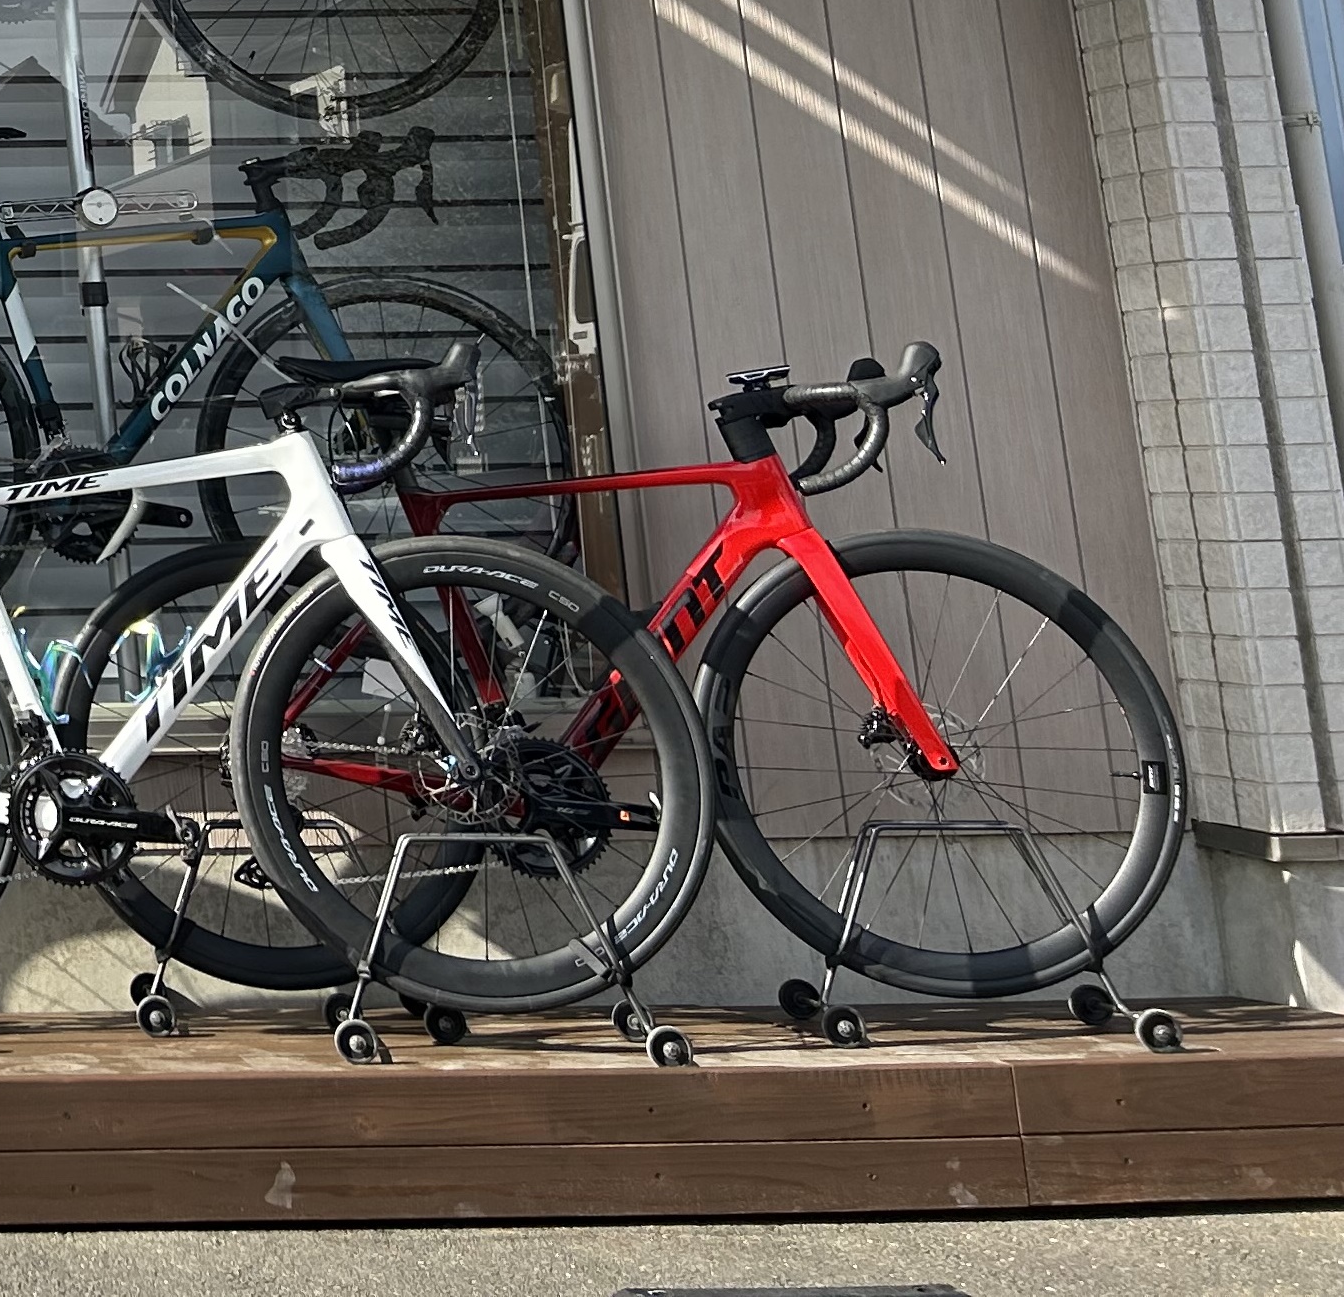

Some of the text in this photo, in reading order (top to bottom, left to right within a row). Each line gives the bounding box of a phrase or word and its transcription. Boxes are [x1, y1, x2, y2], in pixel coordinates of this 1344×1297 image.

[151, 276, 265, 421] COLNAGO
[6, 473, 109, 501] TIME
[359, 559, 421, 656] TIME
[423, 565, 539, 589] DURA-ACE
[146, 540, 282, 743] TIME
[264, 784, 319, 892] DURA-ACE
[614, 848, 679, 944] DURA-ACE
